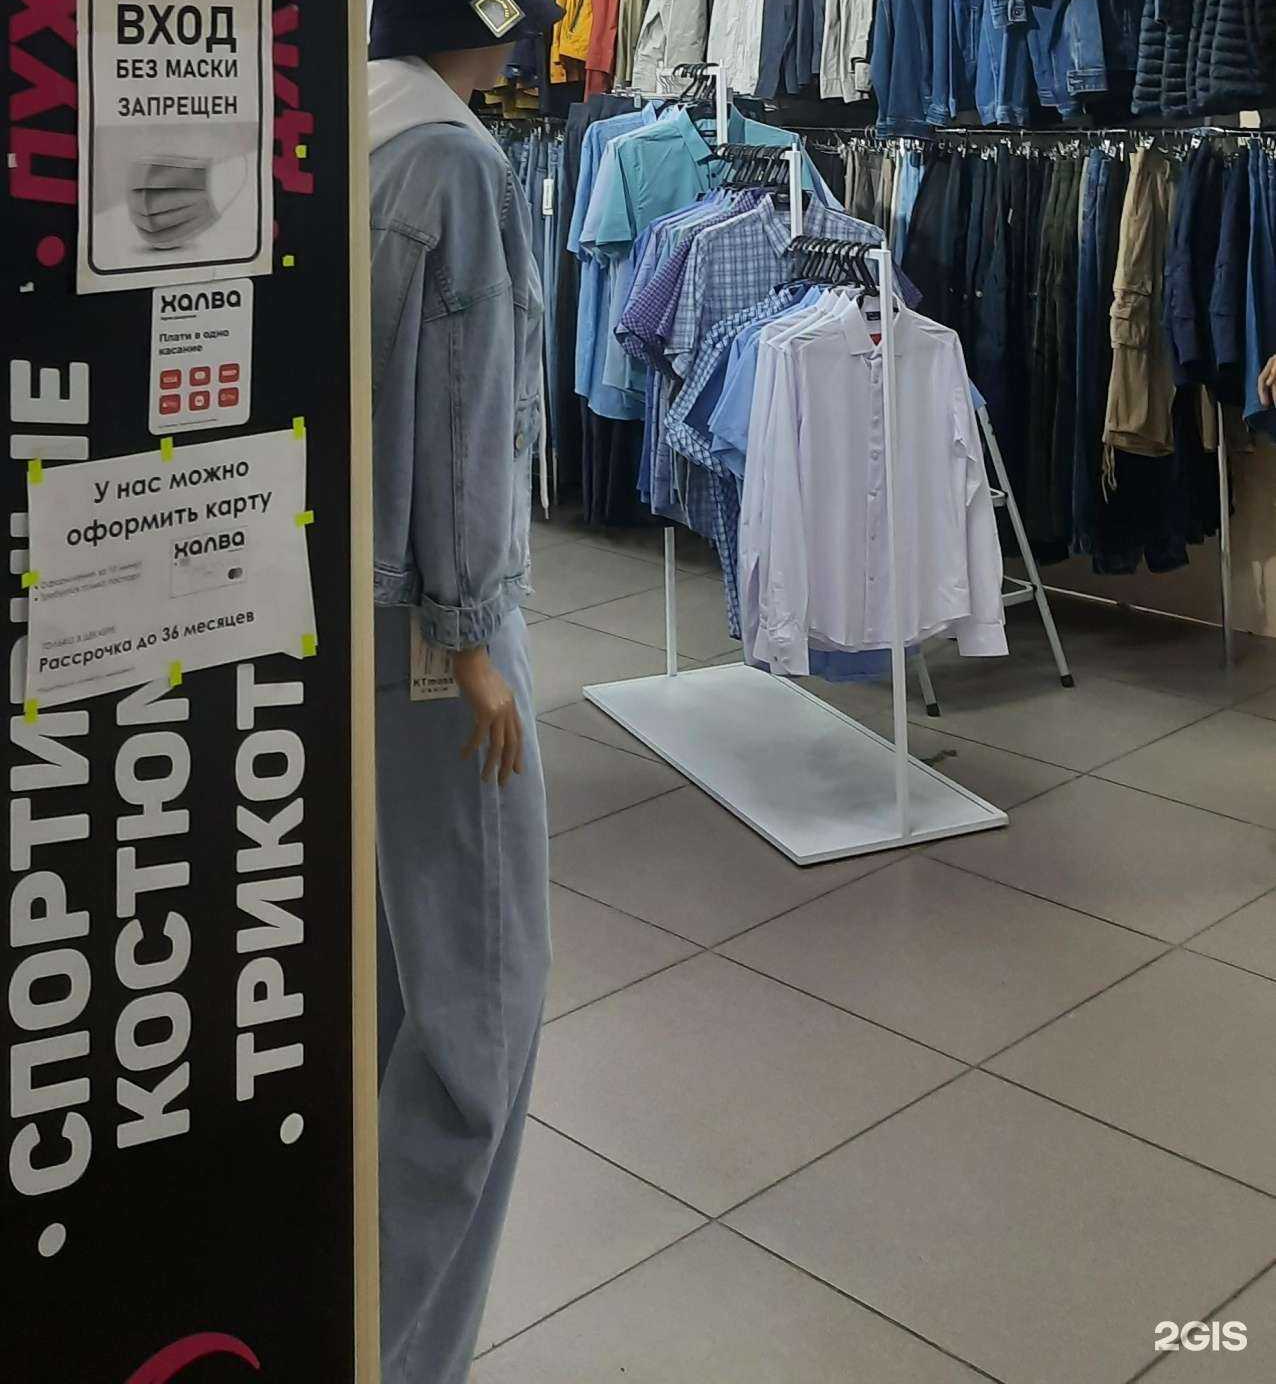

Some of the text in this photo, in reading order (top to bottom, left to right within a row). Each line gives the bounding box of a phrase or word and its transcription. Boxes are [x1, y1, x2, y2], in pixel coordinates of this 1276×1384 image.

[117, 3, 237, 53] ВХОД
[116, 59, 239, 78] БЕЗ МАСКИ
[118, 96, 238, 118] ЗАПРЕЩЕН
[94, 460, 250, 504] У нас можно
[67, 491, 273, 547] оформить карту
[39, 640, 132, 673] Рассрочка
[136, 634, 157, 650] до
[162, 627, 180, 644] 36
[184, 610, 255, 637] месяцев
[9, 358, 92, 1196] СПОРТИЕ
